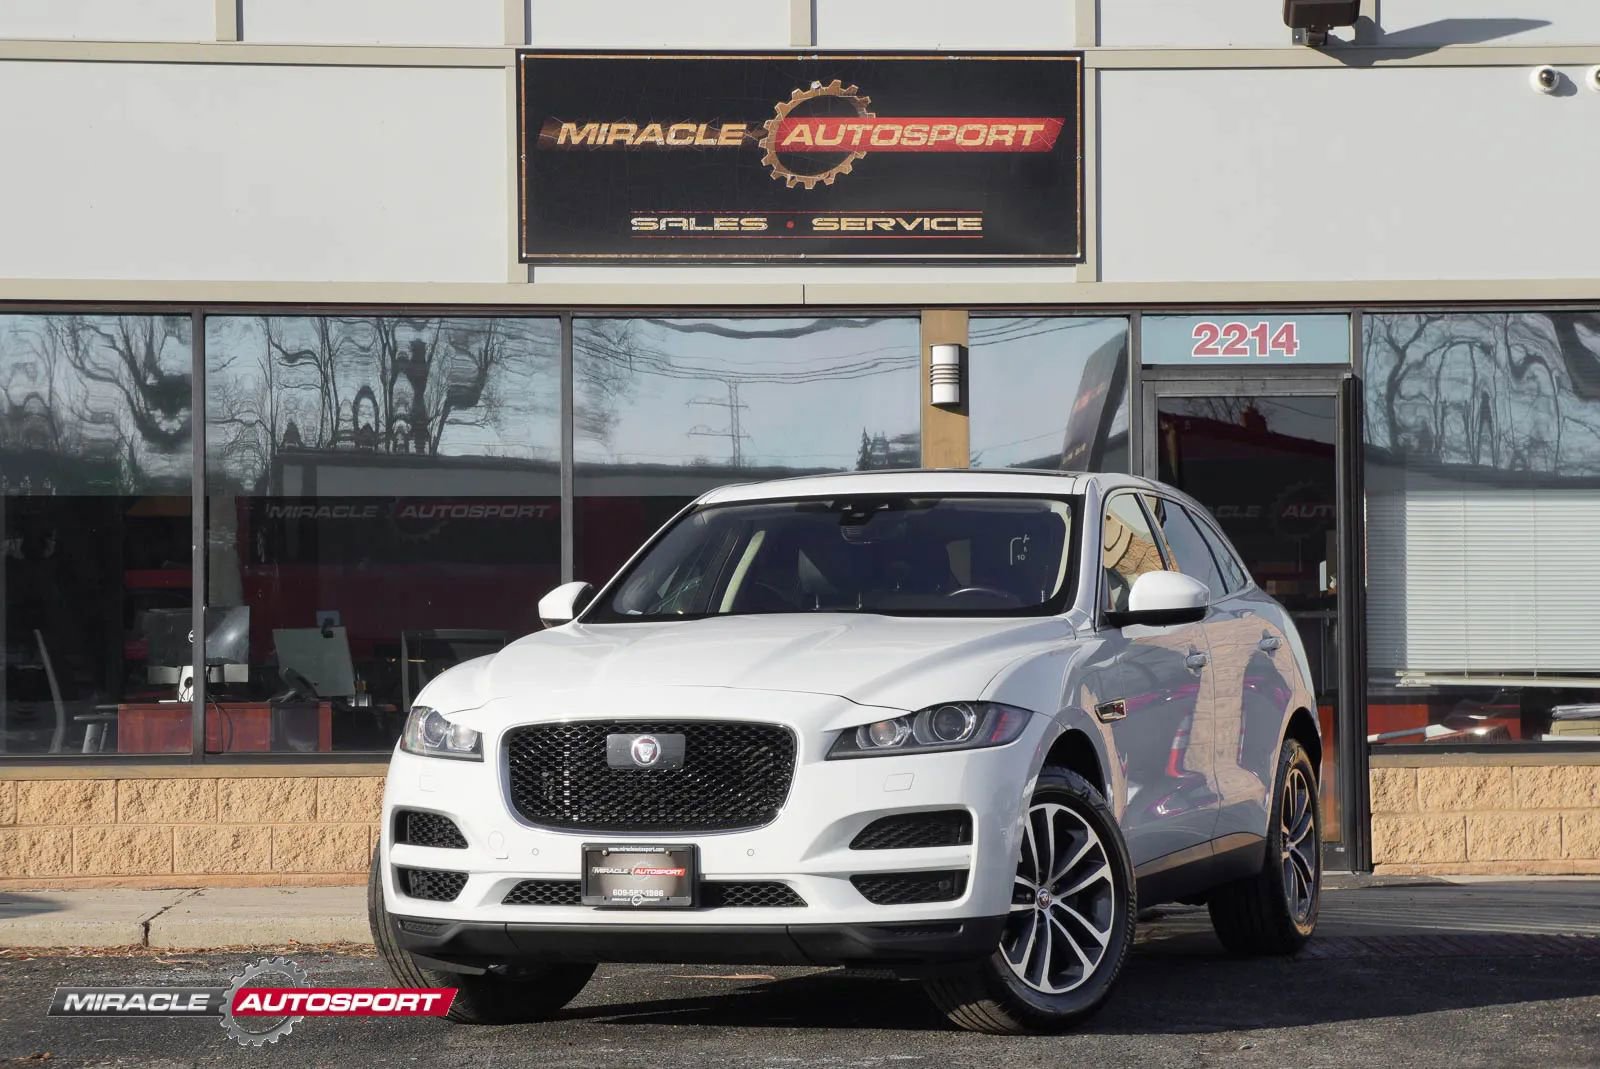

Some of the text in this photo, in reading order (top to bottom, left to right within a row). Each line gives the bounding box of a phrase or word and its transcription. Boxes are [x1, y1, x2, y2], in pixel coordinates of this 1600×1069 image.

[556, 122, 1045, 146] MIRACLE AUTOSPORT
[630, 217, 983, 231] SALES SERVICE
[1192, 321, 1299, 357] 2214
[268, 505, 551, 518] MIRACLE AUTOSPORT
